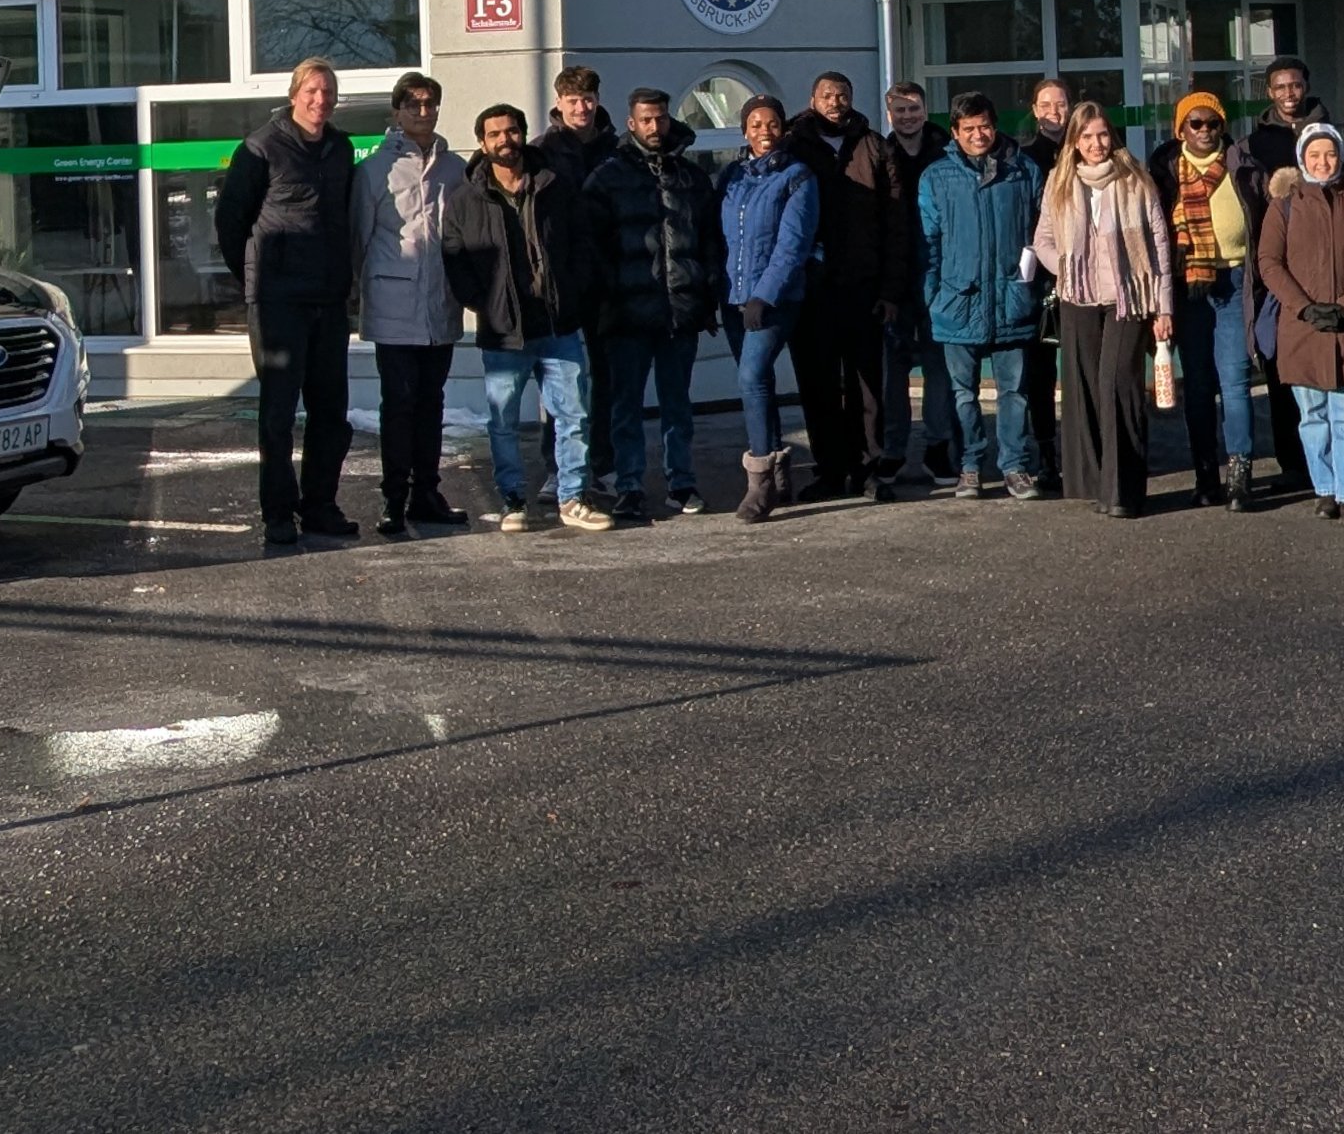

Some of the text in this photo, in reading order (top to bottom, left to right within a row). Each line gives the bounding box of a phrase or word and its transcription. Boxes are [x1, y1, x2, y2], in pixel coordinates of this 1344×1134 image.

[54, 156, 133, 168] Green Energy Center
[23, 423, 42, 447] AP
